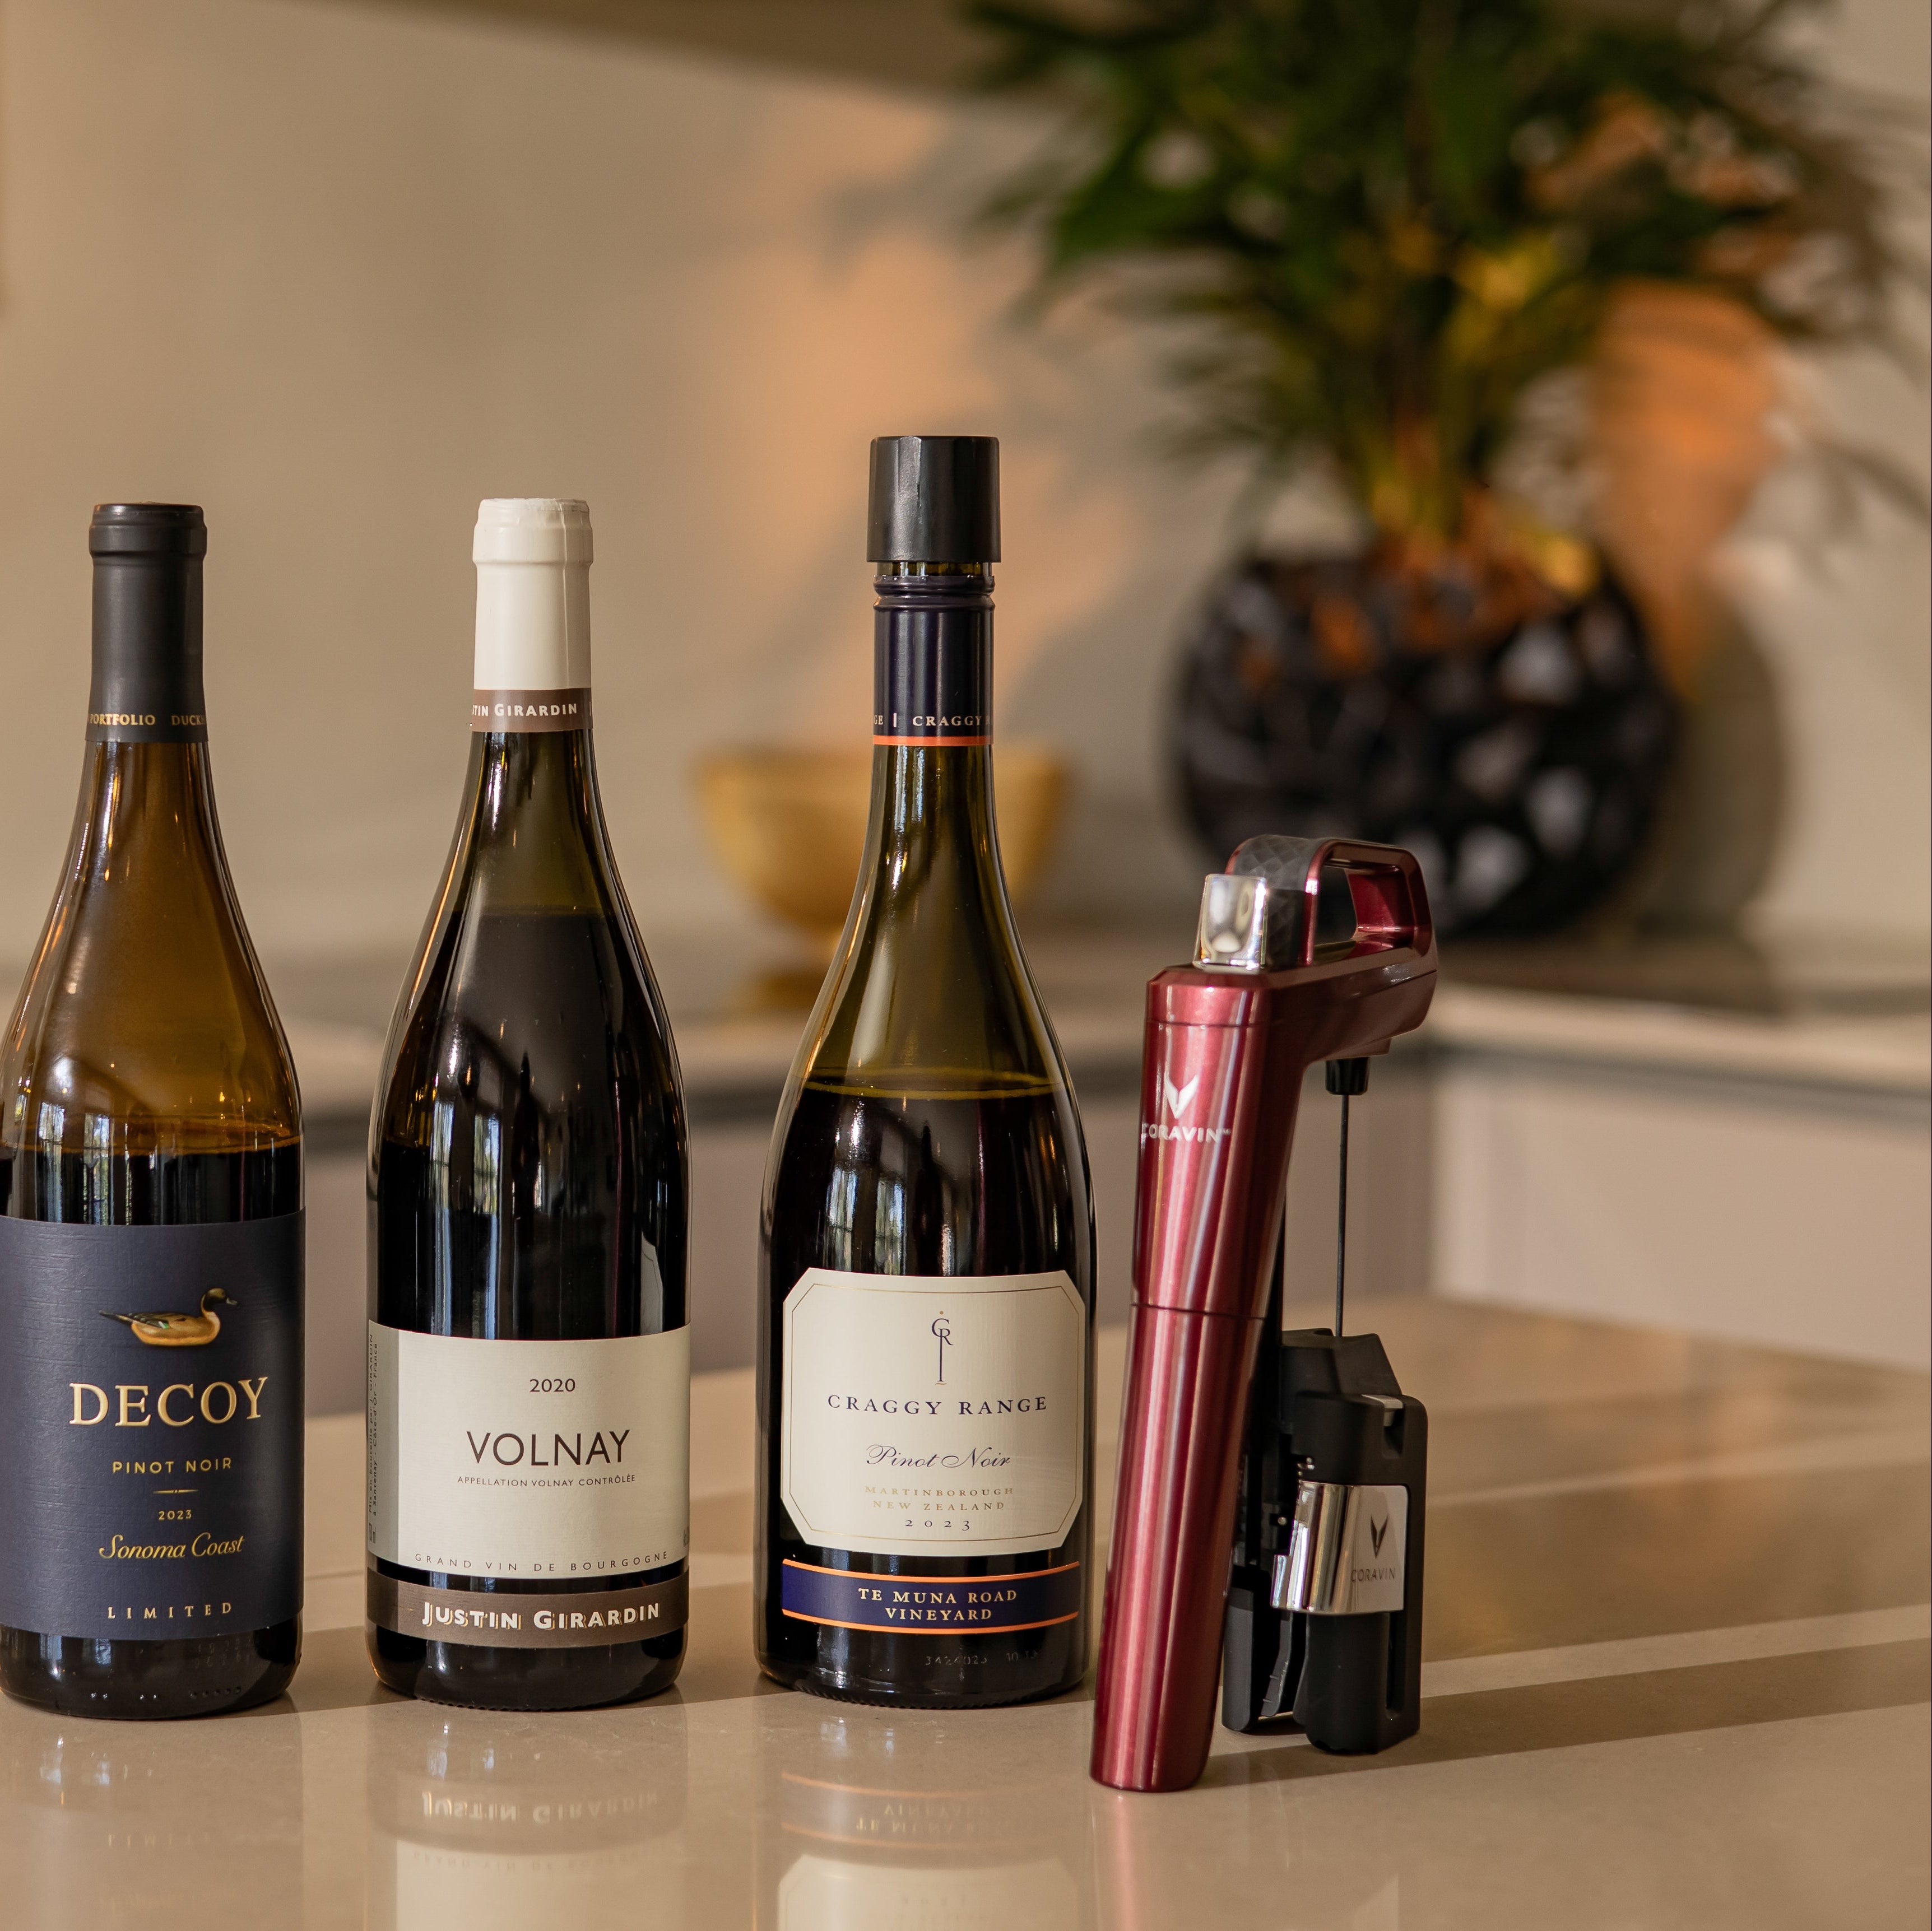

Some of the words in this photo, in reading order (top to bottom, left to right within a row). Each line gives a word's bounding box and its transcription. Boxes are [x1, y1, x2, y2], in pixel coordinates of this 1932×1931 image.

[472, 705, 489, 717] TIN
[494, 703, 577, 716] GIRARDIN
[90, 713, 156, 725] PORTFOLIO
[912, 715, 982, 727] CRAGGY
[529, 1379, 575, 1393] 2020
[69, 1376, 268, 1427] DECOY
[828, 1394, 942, 1415] CRAGGY
[959, 1396, 1047, 1415] RANGE
[466, 1429, 630, 1467] VOLNAY
[866, 1444, 940, 1468] Pinot
[941, 1446, 1011, 1469] Noir
[112, 1460, 174, 1474] PINOT
[186, 1458, 231, 1473] NOIR
[457, 1476, 528, 1487] APPELLATION
[531, 1478, 574, 1487] VOLNAY
[578, 1473, 636, 1486] CONTRÔLÉE
[865, 1486, 1014, 1497] MARTINBOROUGH
[872, 1500, 912, 1510] NEW
[923, 1501, 1005, 1511] ZEALAND
[159, 1510, 193, 1521] 2023
[904, 1519, 970, 1532] 2023
[98, 1534, 185, 1560] Sonoma
[191, 1532, 245, 1557] Coast
[415, 1553, 472, 1569] GRAND
[485, 1562, 517, 1571] VIN
[533, 1563, 555, 1572] DE
[570, 1551, 668, 1571] BOURGOGNE
[1350, 1567, 1395, 1582] CORAVIN
[858, 1587, 883, 1602] TE
[893, 1590, 957, 1604] MUNA
[968, 1589, 1018, 1603] ROAD
[108, 1602, 231, 1619] LIMITED
[421, 1602, 522, 1630] JUSTIN
[533, 1603, 661, 1630] GIRARDIN
[885, 1607, 992, 1621] VINEYARD
